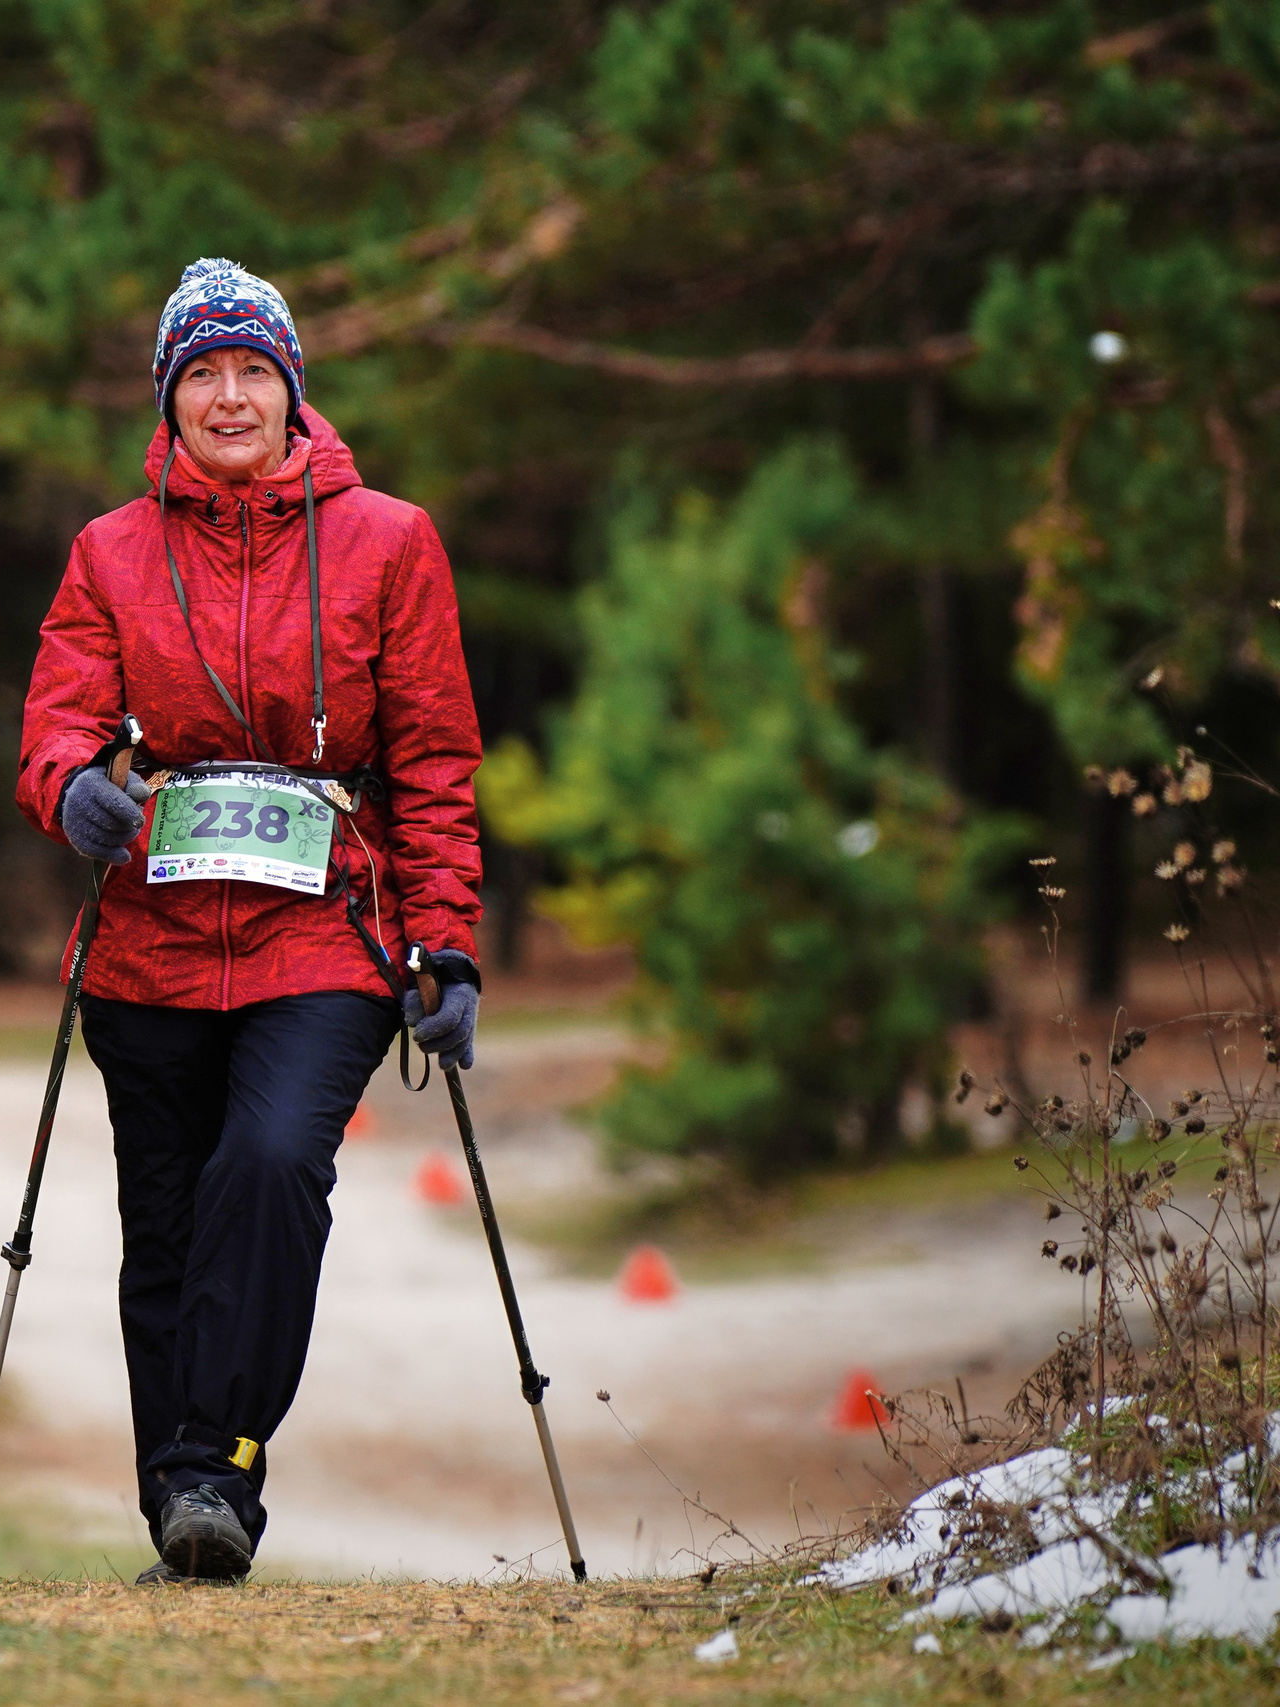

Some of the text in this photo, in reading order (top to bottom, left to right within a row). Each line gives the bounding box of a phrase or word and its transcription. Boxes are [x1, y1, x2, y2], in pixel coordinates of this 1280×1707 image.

[191, 800, 289, 843] 238
[298, 800, 329, 821] XS
[63, 957, 87, 1044] Nordic walking
[464, 1146, 488, 1218] Nordic walking
